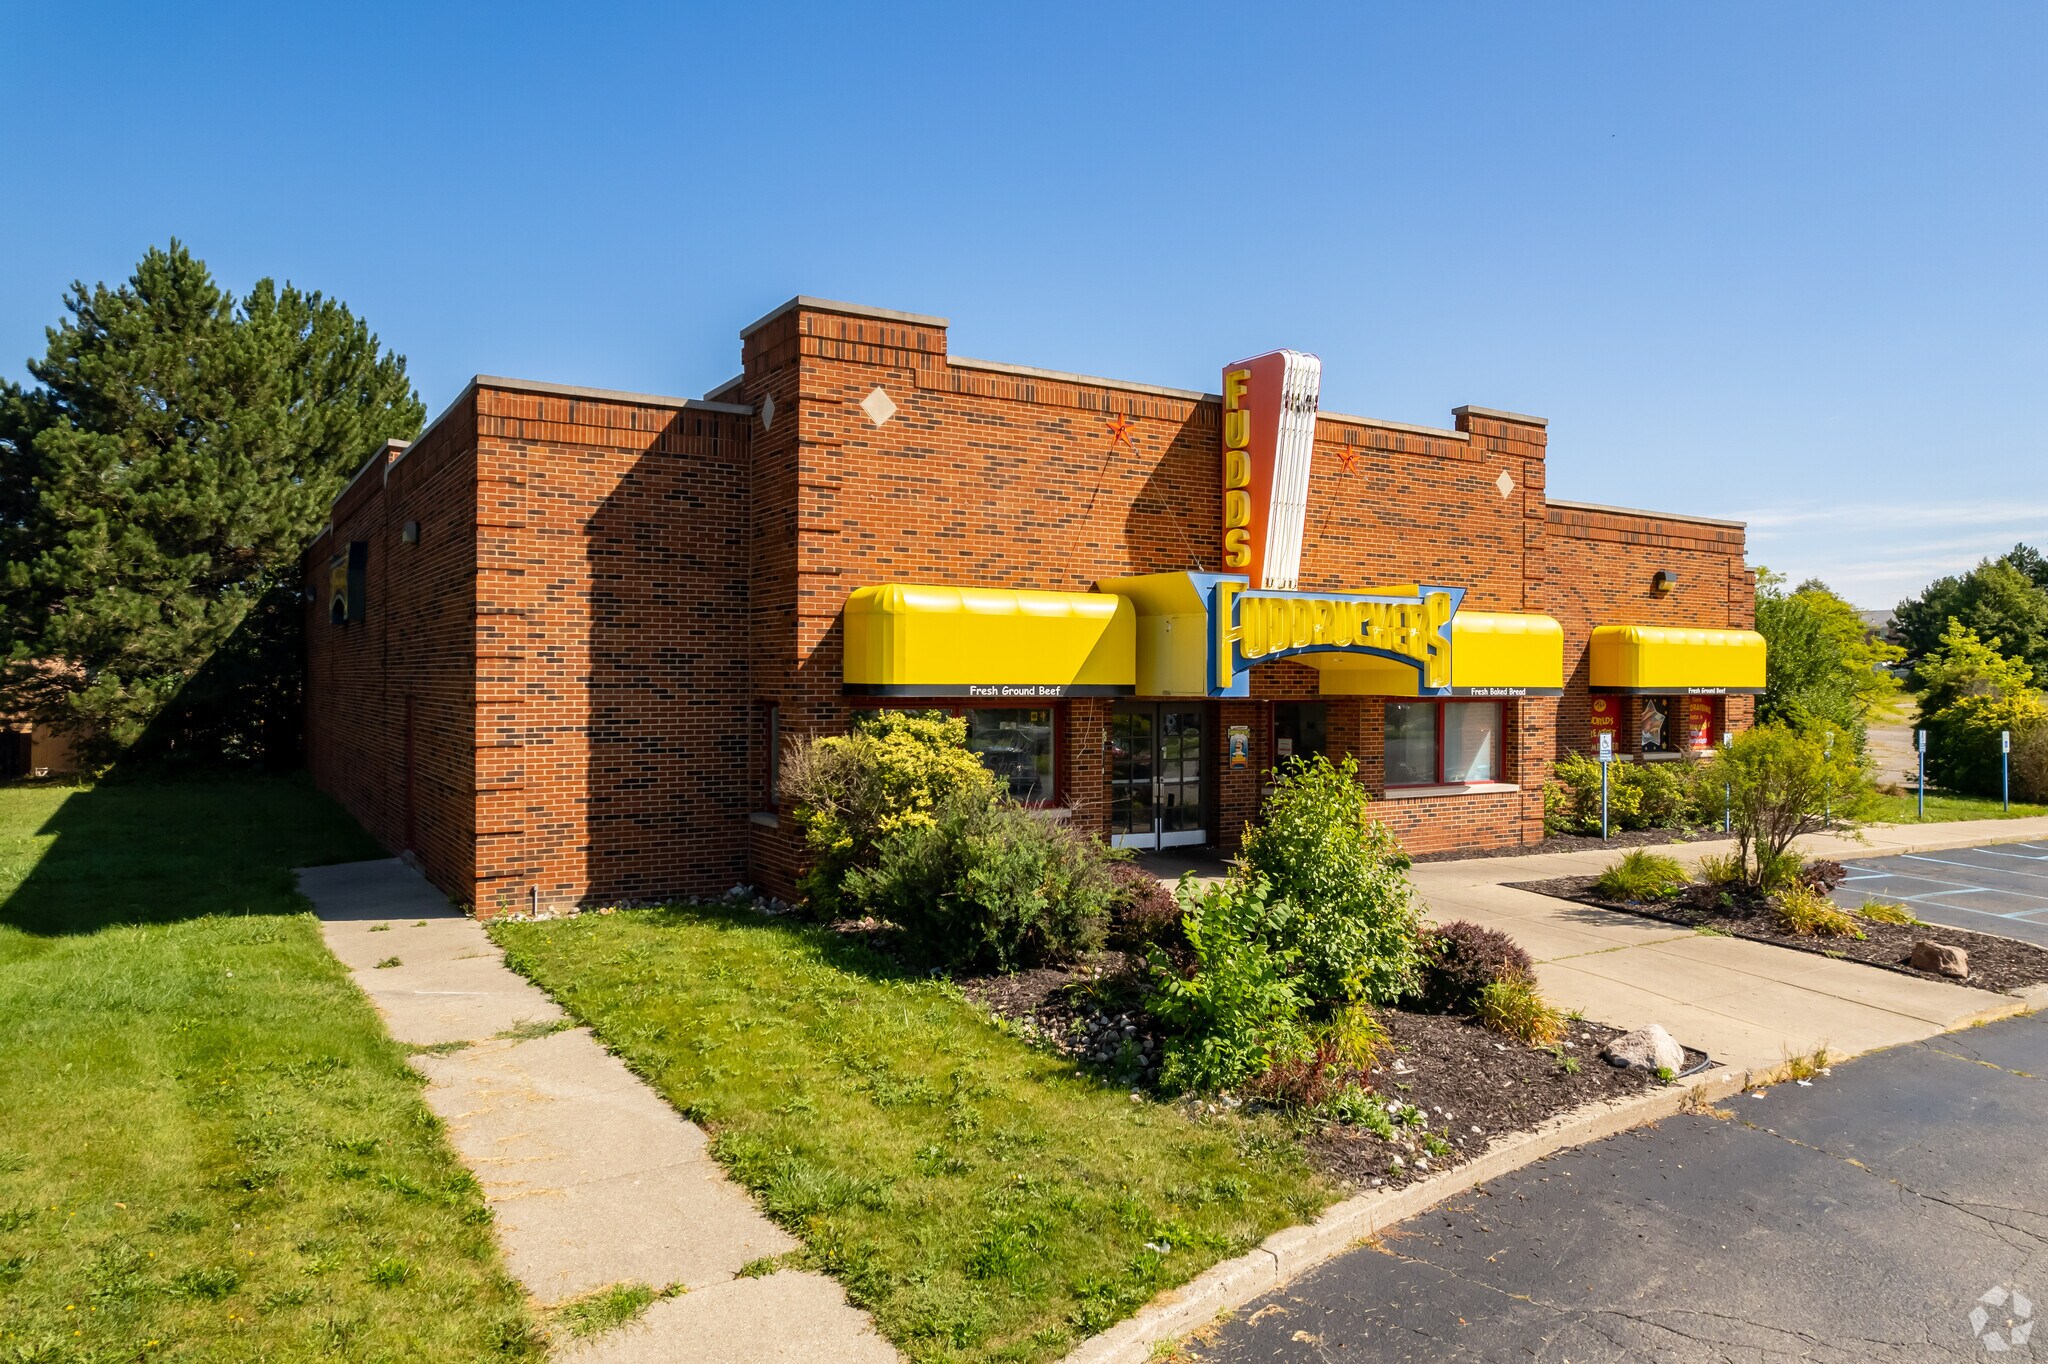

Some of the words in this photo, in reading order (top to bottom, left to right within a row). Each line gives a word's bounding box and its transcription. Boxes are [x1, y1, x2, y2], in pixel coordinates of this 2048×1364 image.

[1225, 369, 1251, 568] FUDDS
[1216, 581, 1451, 688] FUDDRUCKERS
[969, 685, 998, 696] Fresh
[1001, 685, 1035, 696] Ground
[1038, 685, 1061, 696] Beef
[1471, 687, 1489, 696] Fresh
[1490, 687, 1508, 696] Baked
[1509, 687, 1526, 696] Bread
